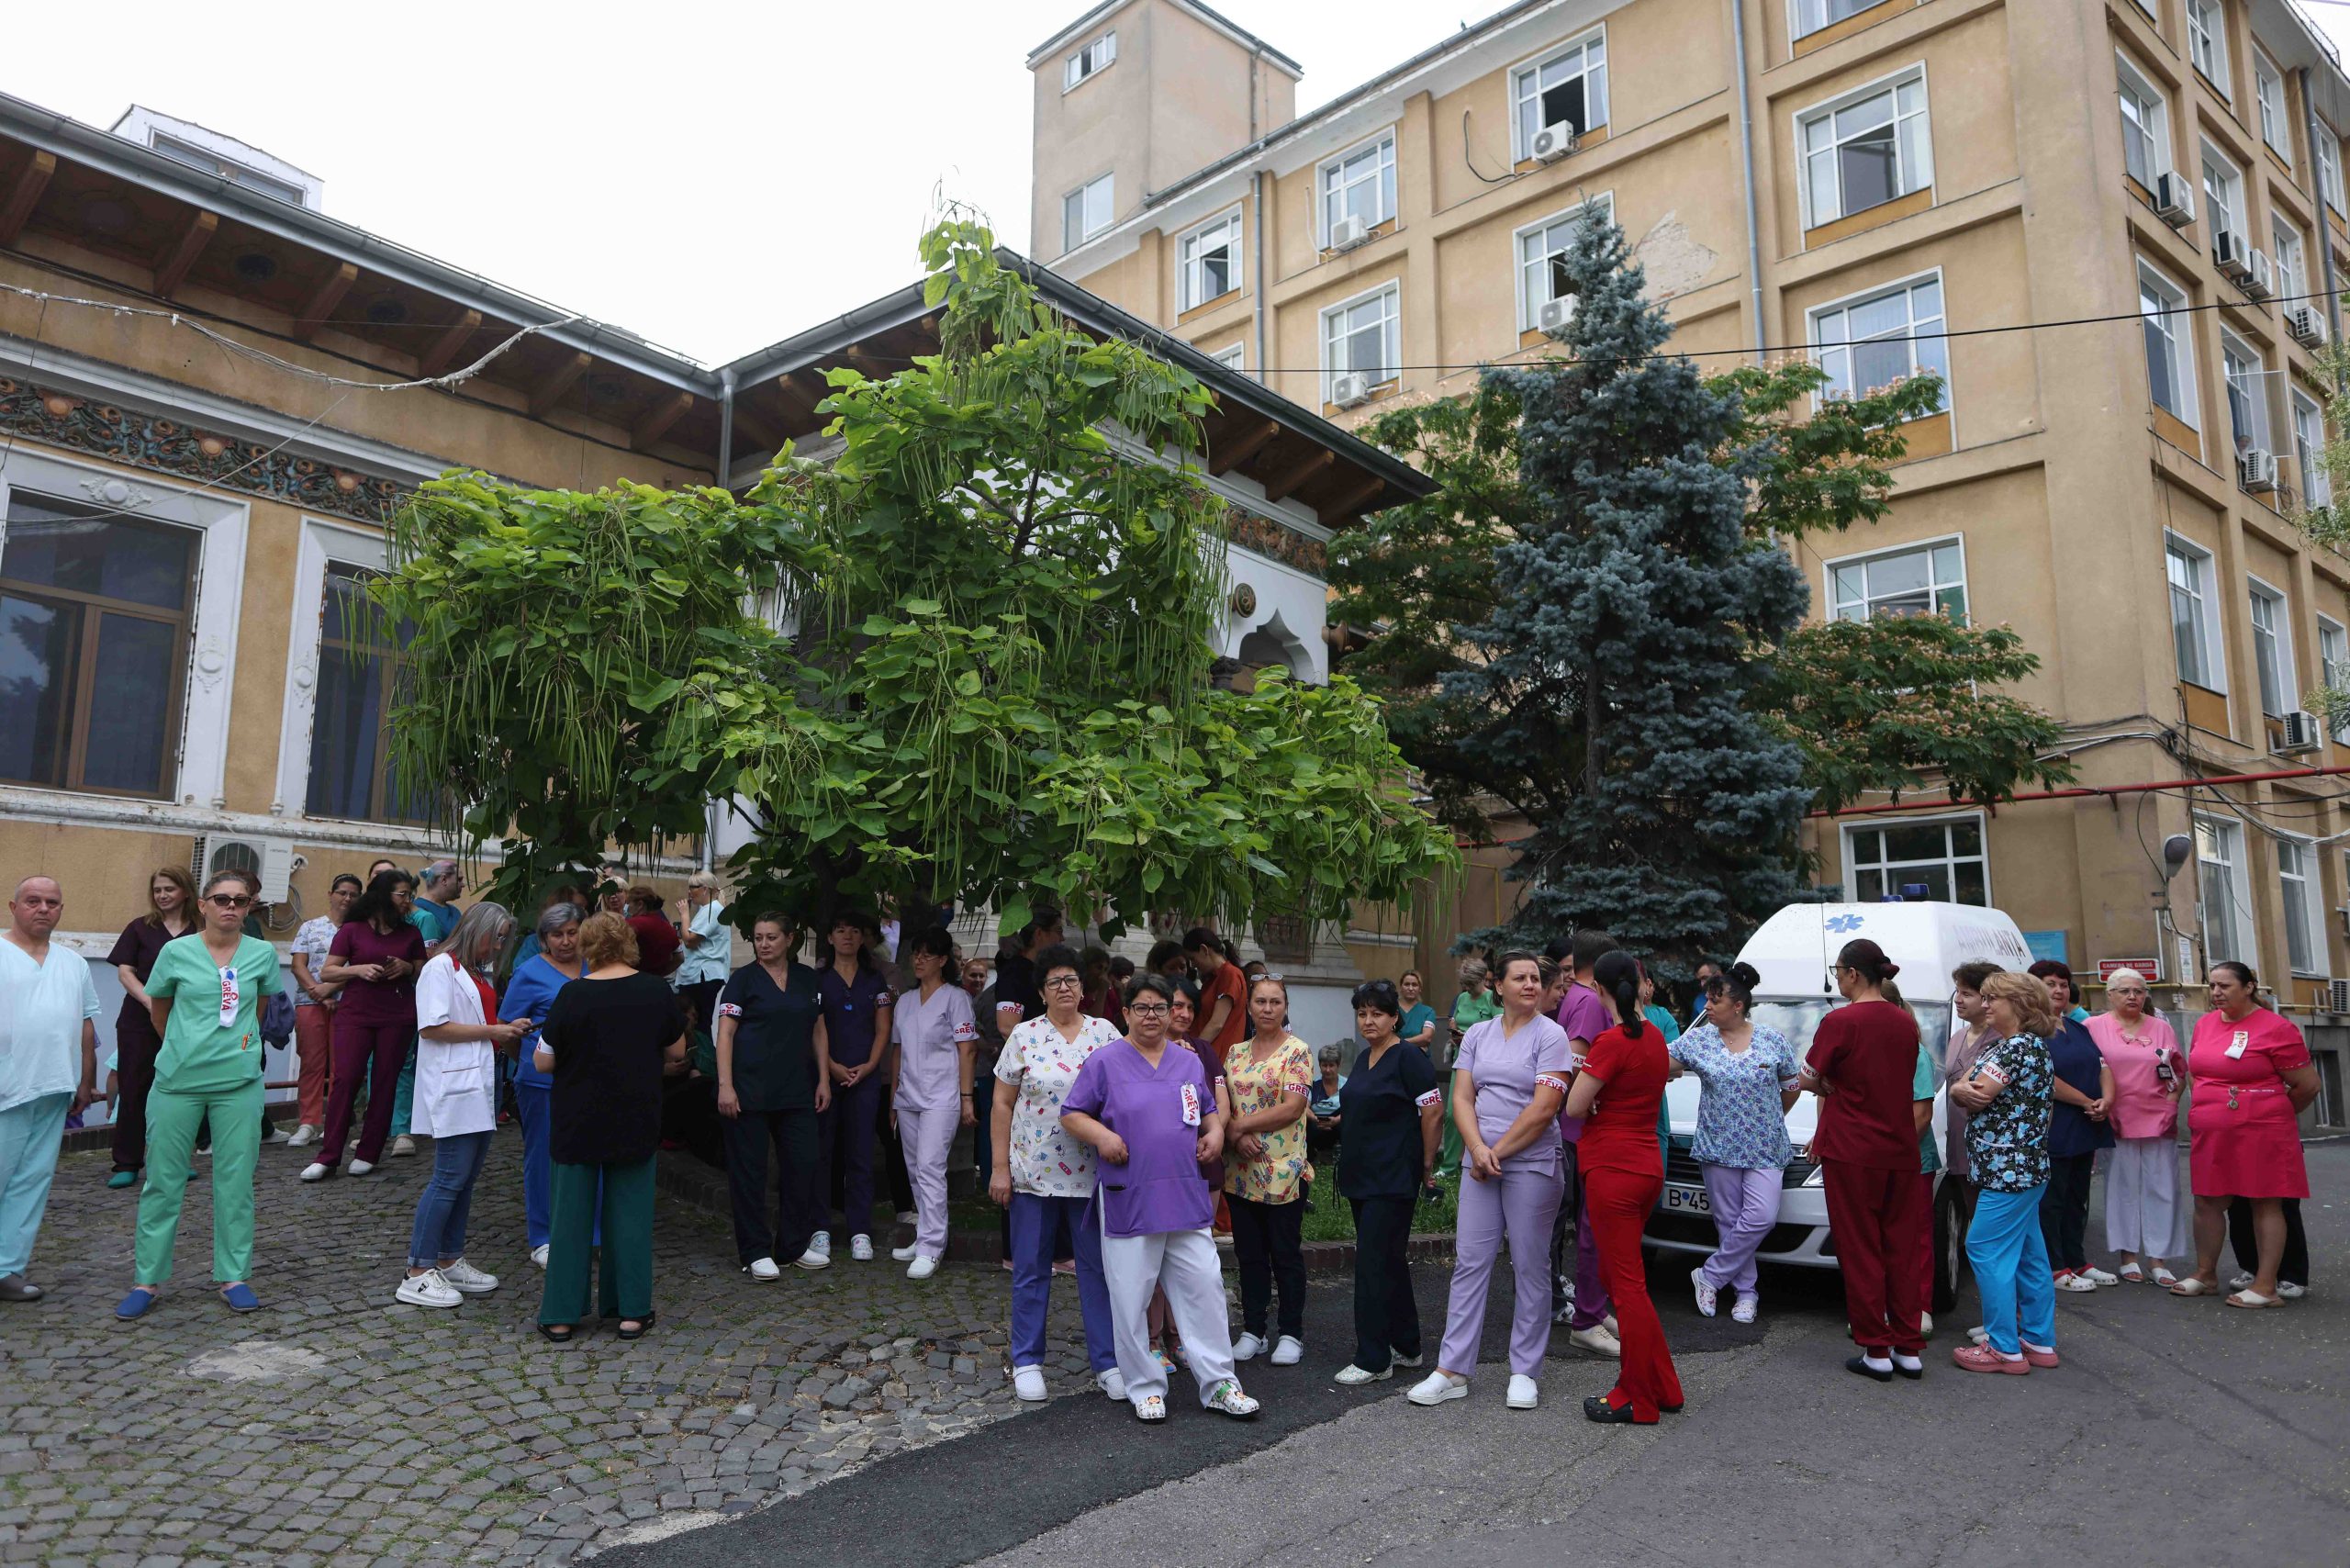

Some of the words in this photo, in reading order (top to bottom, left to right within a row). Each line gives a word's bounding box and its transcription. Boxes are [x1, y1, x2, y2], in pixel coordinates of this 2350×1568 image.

[221, 980, 232, 1011] GREVĂ
[1002, 1005, 1024, 1014] GREV
[955, 1025, 975, 1035] GREV
[1288, 1082, 1310, 1097] GREV
[1422, 1094, 1441, 1106] GRE
[1669, 1189, 1681, 1207] B
